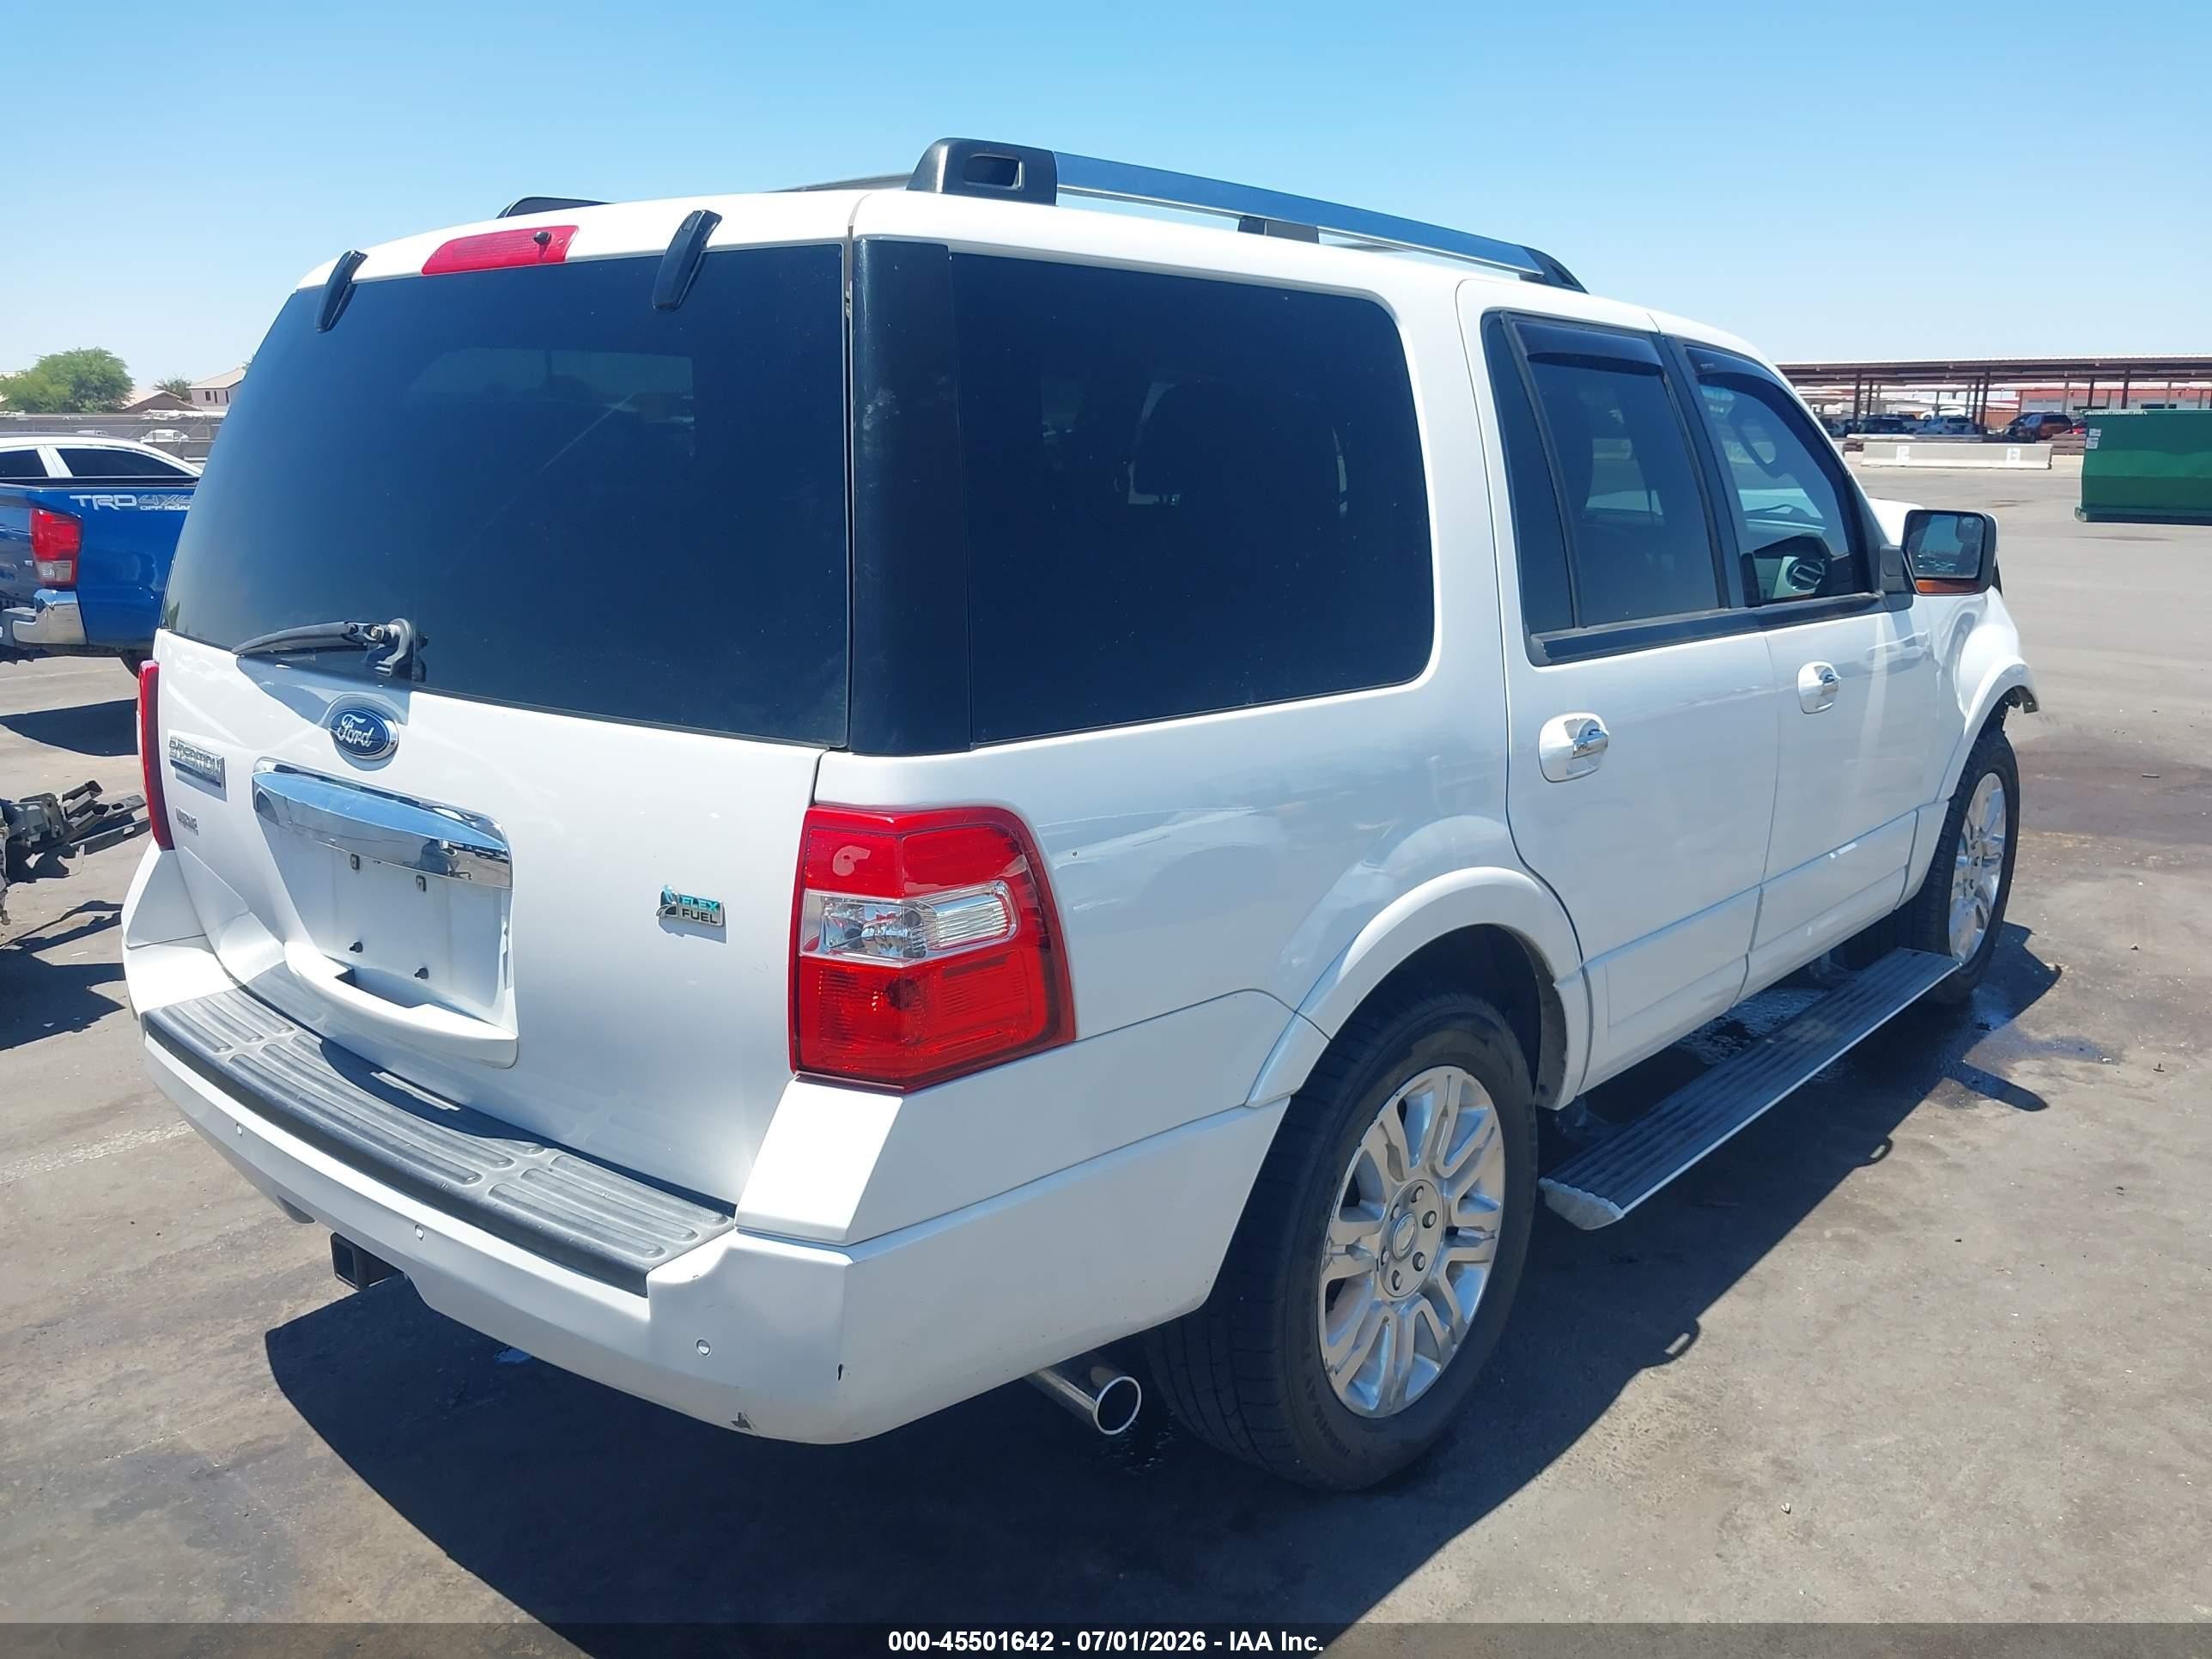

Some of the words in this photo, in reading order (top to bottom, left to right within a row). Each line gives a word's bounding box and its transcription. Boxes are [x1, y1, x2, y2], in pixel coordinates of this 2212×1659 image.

[69, 495, 137, 510] TRD
[337, 714, 375, 748] Ford
[682, 896, 719, 912] FLEX
[682, 908, 718, 924] FUEL
